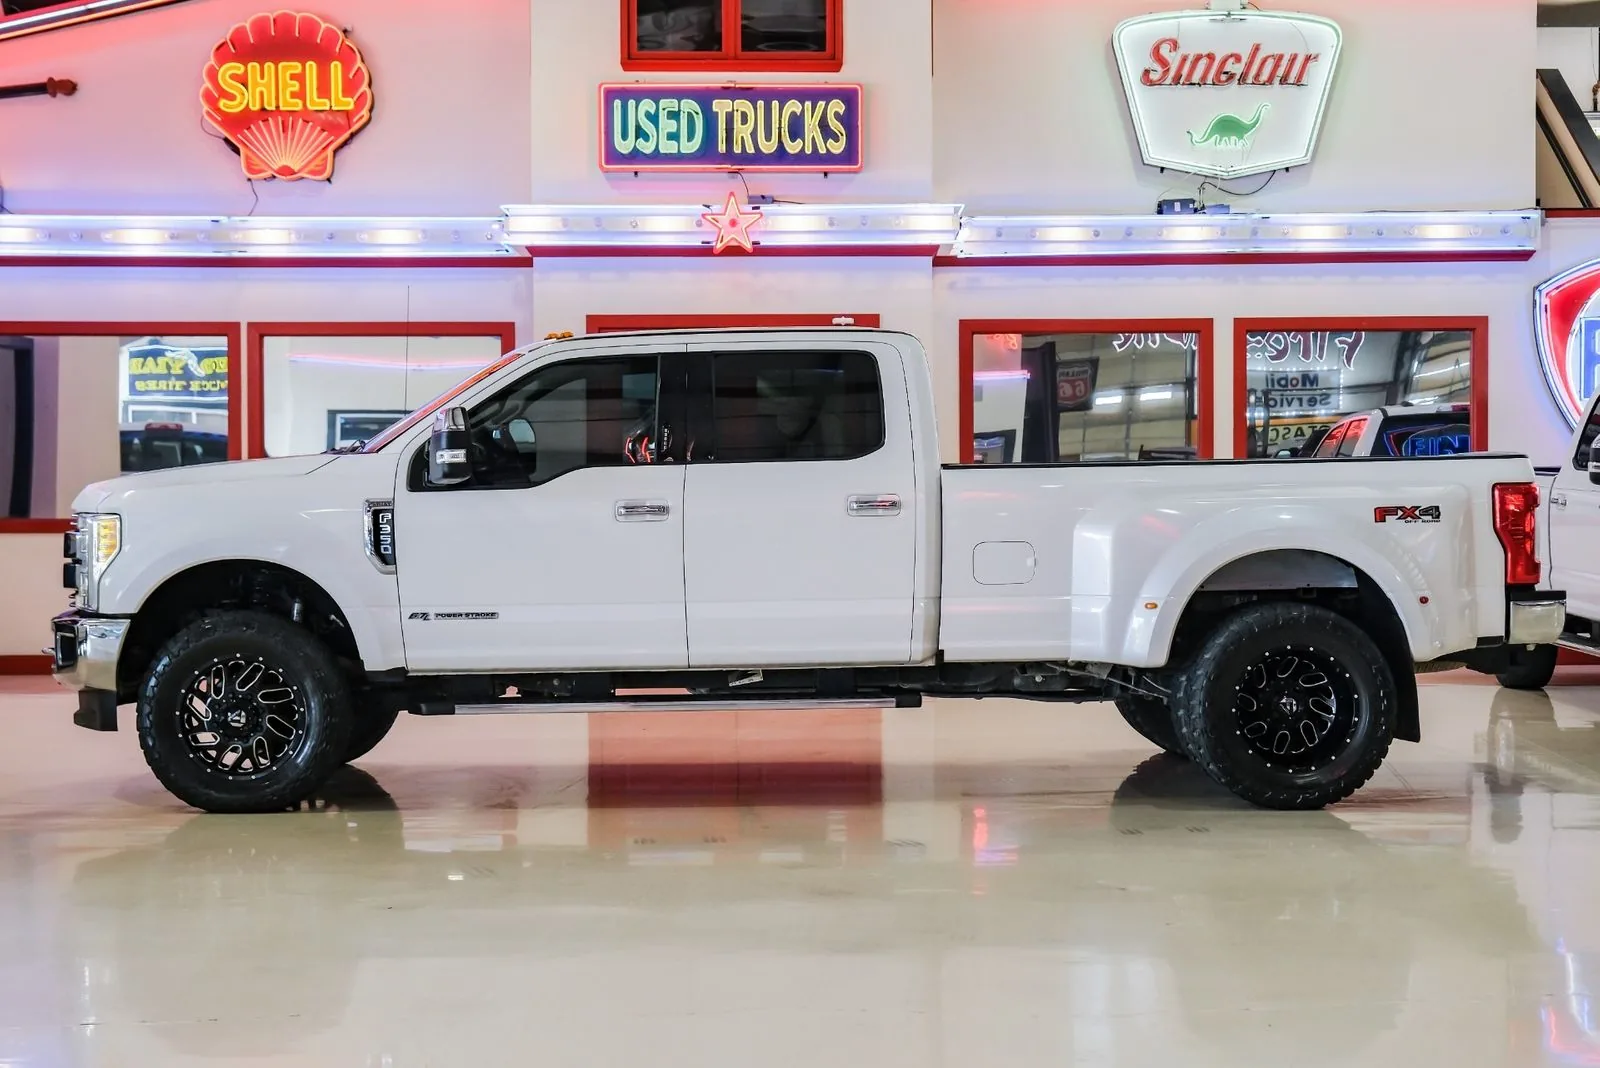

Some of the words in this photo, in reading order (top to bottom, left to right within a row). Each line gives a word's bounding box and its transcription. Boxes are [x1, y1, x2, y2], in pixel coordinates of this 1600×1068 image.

[217, 61, 354, 112] SHELL
[1140, 38, 1321, 86] Sinclair
[613, 98, 703, 154] USED
[712, 98, 847, 154] TRUCKS
[1374, 505, 1441, 523] FX4
